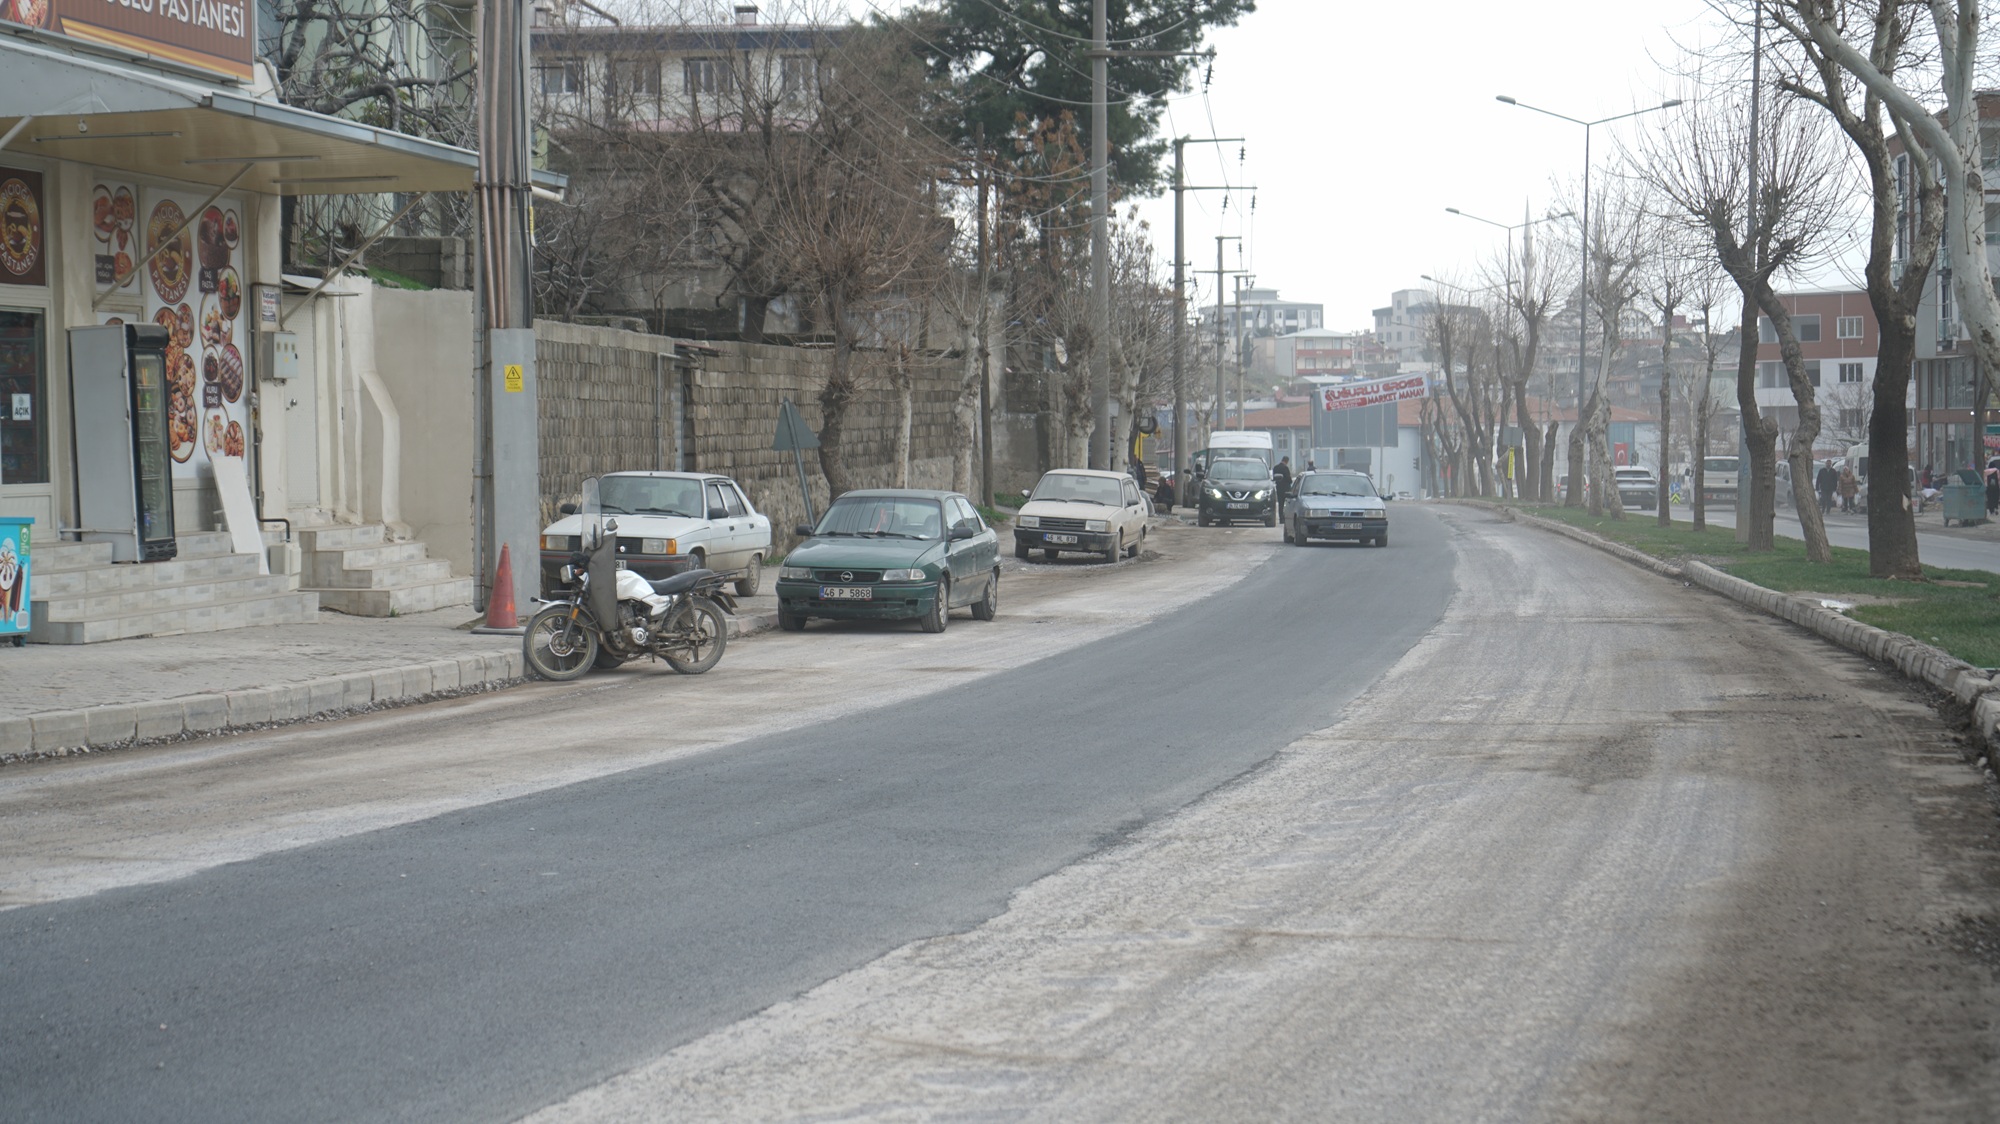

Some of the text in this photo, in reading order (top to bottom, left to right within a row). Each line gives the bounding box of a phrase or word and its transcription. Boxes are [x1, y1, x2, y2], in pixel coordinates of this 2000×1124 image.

[1368, 392, 1397, 404] MARKET
[824, 588, 871, 598] 46 P 5868
